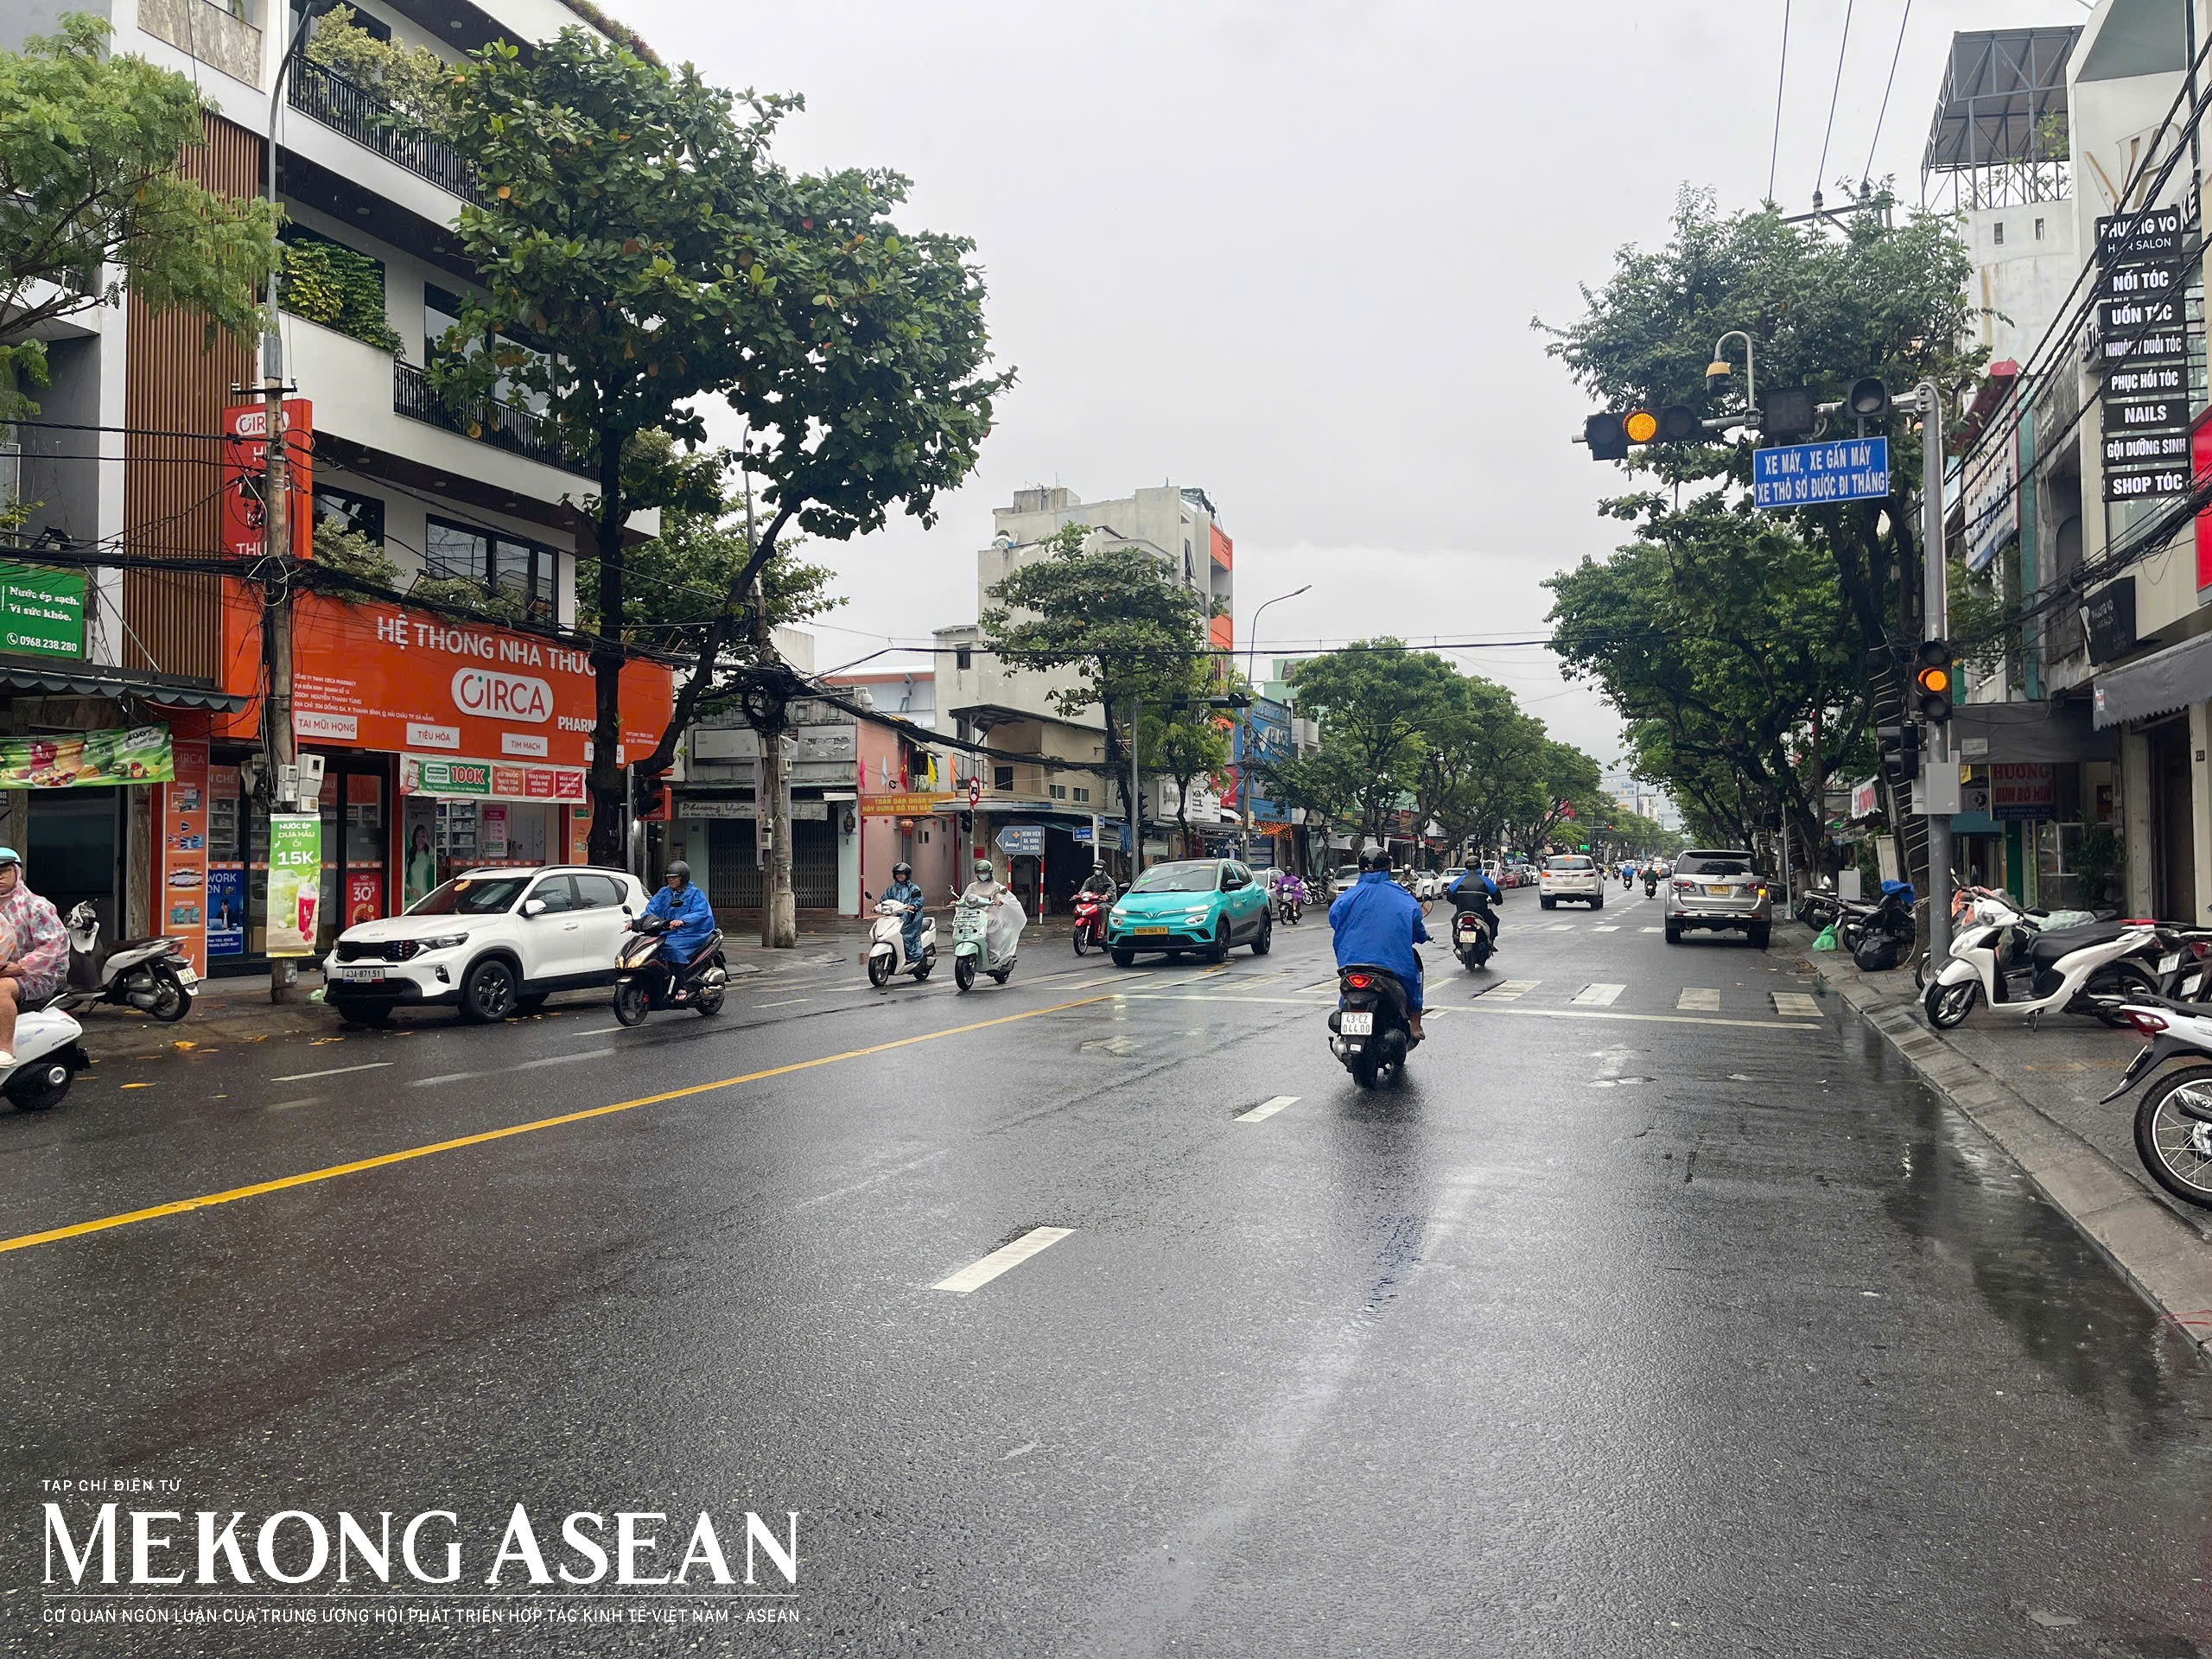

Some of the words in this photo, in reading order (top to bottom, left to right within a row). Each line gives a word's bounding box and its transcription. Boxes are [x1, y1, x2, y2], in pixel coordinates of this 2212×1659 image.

[2136, 238, 2171, 251] SALON
[2113, 270, 2138, 292] NỐI
[2141, 269, 2169, 289] TÓC
[2112, 303, 2142, 326] UỐN
[2165, 334, 2182, 353] TÓC
[2111, 375, 2138, 392] PHỤC
[2159, 369, 2178, 387] TÓC
[2125, 404, 2167, 423] NAILS
[239, 415, 288, 432] CIR
[1765, 455, 1778, 475] XE
[1782, 449, 1804, 474] MÁY,
[1810, 450, 1823, 471] XE
[1827, 442, 1847, 468] GẮN
[1851, 442, 1871, 466] MÁY
[2107, 440, 2124, 461] GỘI
[2162, 438, 2186, 454] SINH
[1758, 483, 1770, 503] XE
[1773, 477, 1792, 501] THÔ
[1796, 474, 1808, 499] SƠ
[1811, 472, 1836, 500] ĐƯỢC
[1839, 479, 1848, 496] ĐI
[2113, 476, 2152, 495] SHOP
[2155, 471, 2183, 491] TÓC
[10, 587, 37, 599] Nước
[39, 591, 52, 602] ép
[23, 607, 41, 616] sức
[377, 613, 409, 651] HỆ
[20, 636, 77, 652] 0968.238.280
[461, 675, 545, 717] CIRCA
[299, 719, 311, 728] TAI
[314, 719, 329, 729] MŨI
[332, 723, 355, 733] HỌNG
[558, 715, 596, 734] PHARM
[417, 730, 434, 741] TIÊU
[435, 732, 451, 742] HÓA
[451, 766, 485, 785] 100K
[277, 850, 314, 865] 15K
[1344, 1024, 1370, 1033] 044.00
